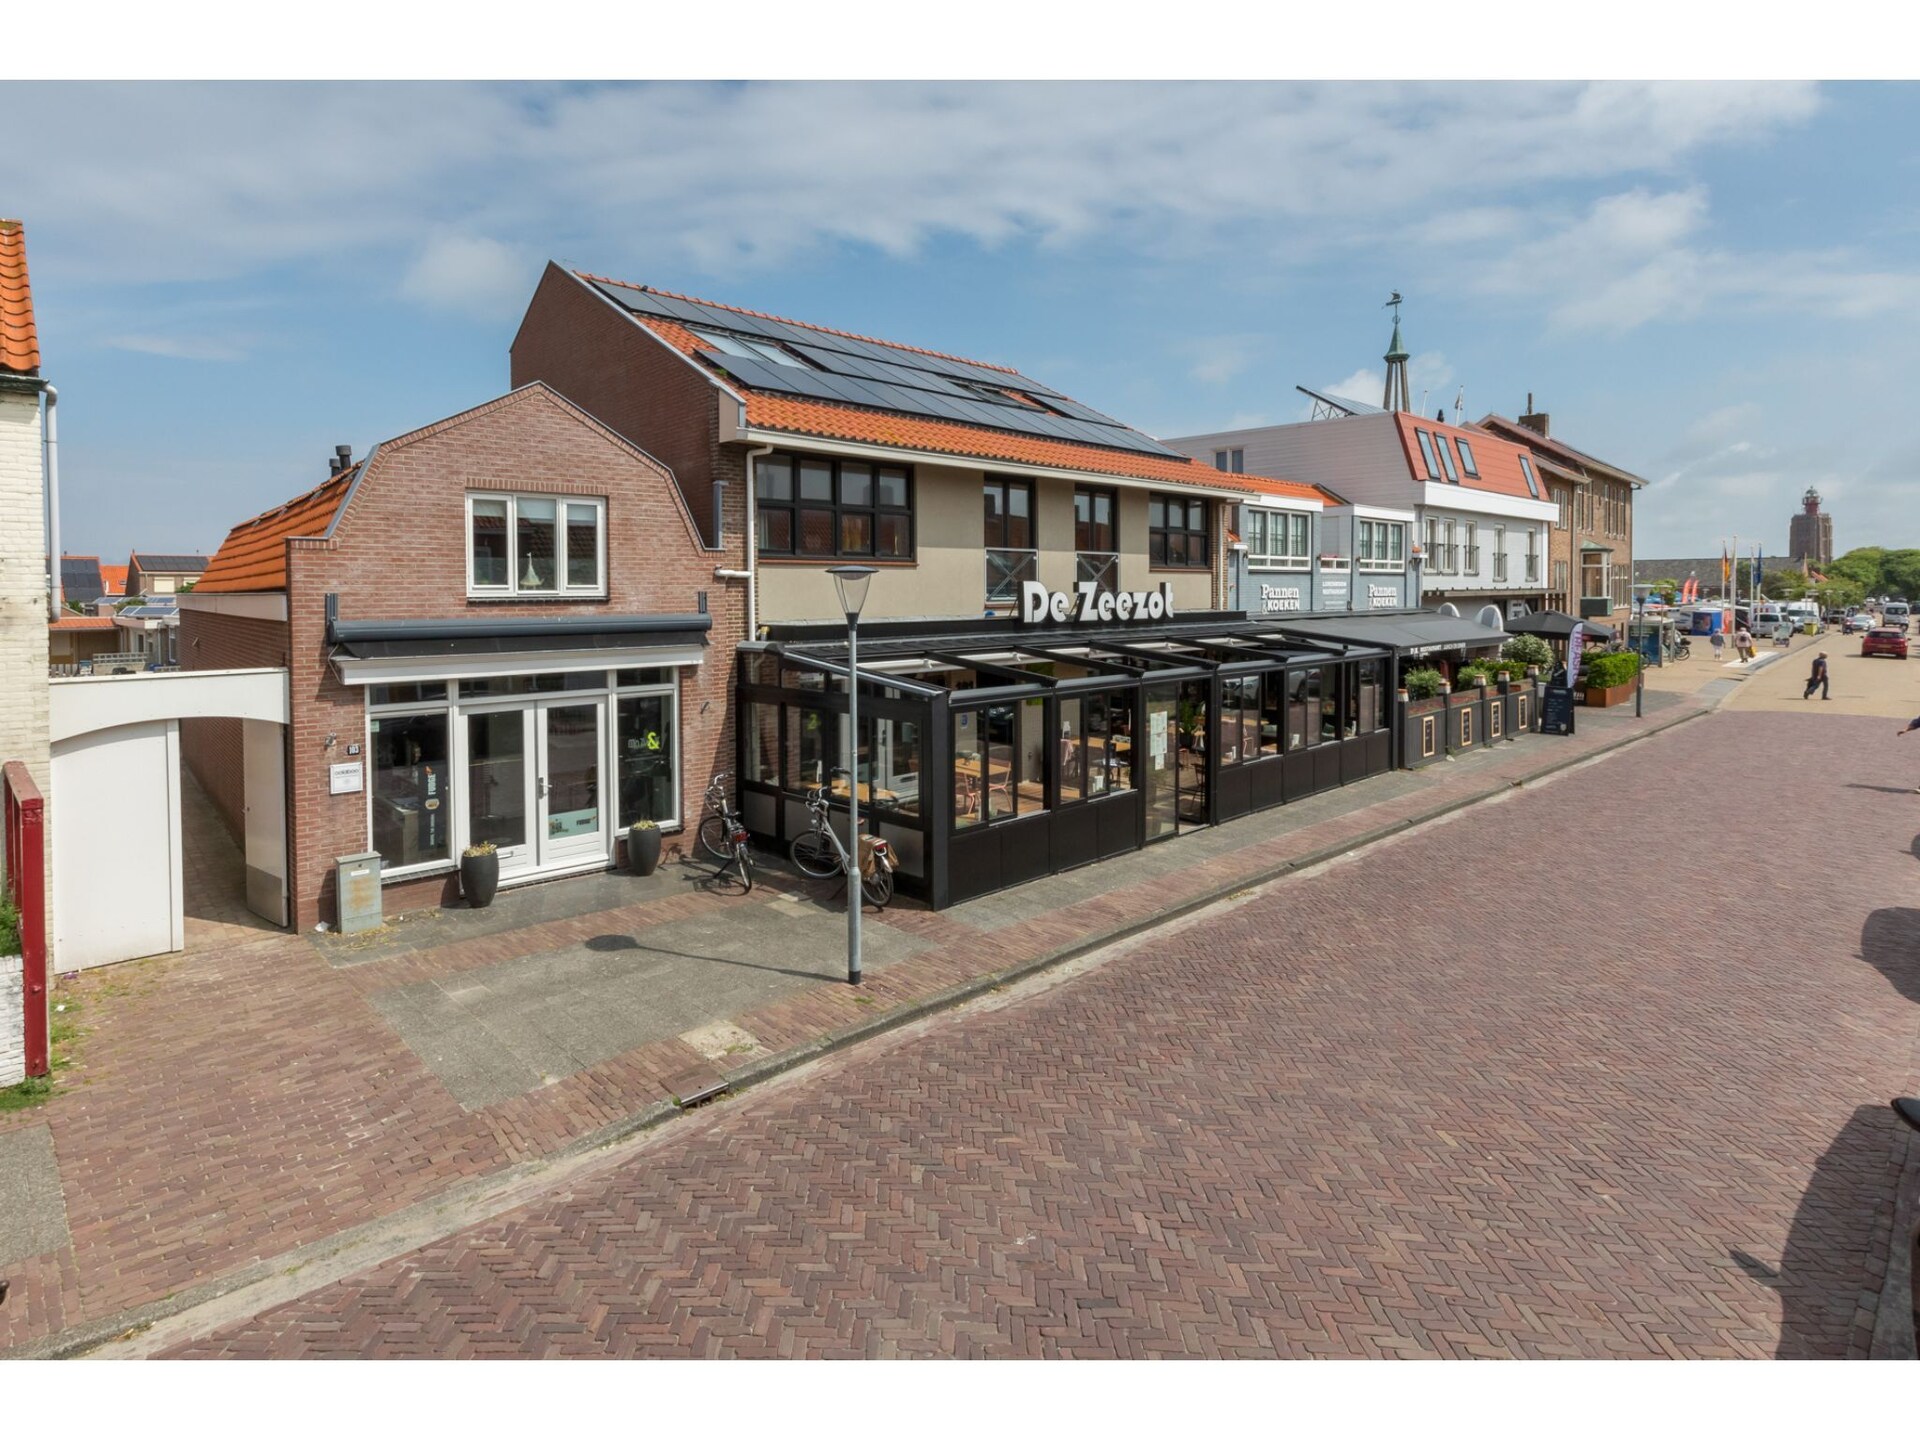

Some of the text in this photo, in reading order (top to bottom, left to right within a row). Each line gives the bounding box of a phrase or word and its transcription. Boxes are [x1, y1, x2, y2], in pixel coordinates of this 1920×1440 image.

[1261, 583, 1299, 599] Pannen
[1368, 583, 1397, 597] Pannen
[1022, 580, 1175, 623] De Zeezot
[1267, 599, 1300, 611] KOEKEN
[1373, 596, 1398, 608] KOEKEN
